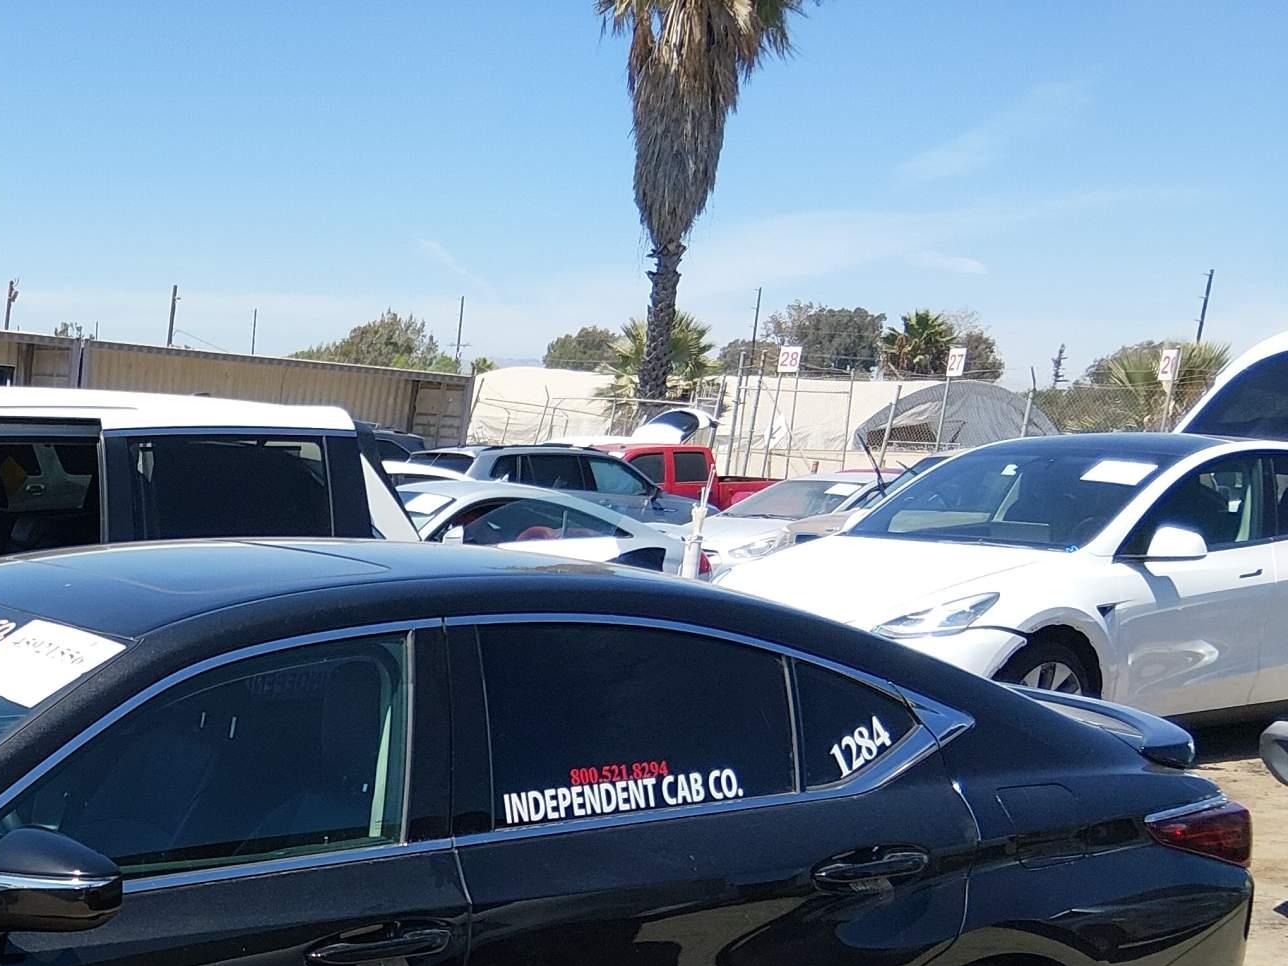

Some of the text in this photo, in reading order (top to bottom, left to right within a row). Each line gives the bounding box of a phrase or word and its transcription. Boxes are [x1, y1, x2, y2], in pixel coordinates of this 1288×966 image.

[780, 351, 799, 367] 28
[948, 353, 964, 371] 27
[830, 715, 892, 779] 1284
[570, 760, 669, 785] 800.521.8294
[503, 768, 745, 825] INDEPENDENT CAB CO.
